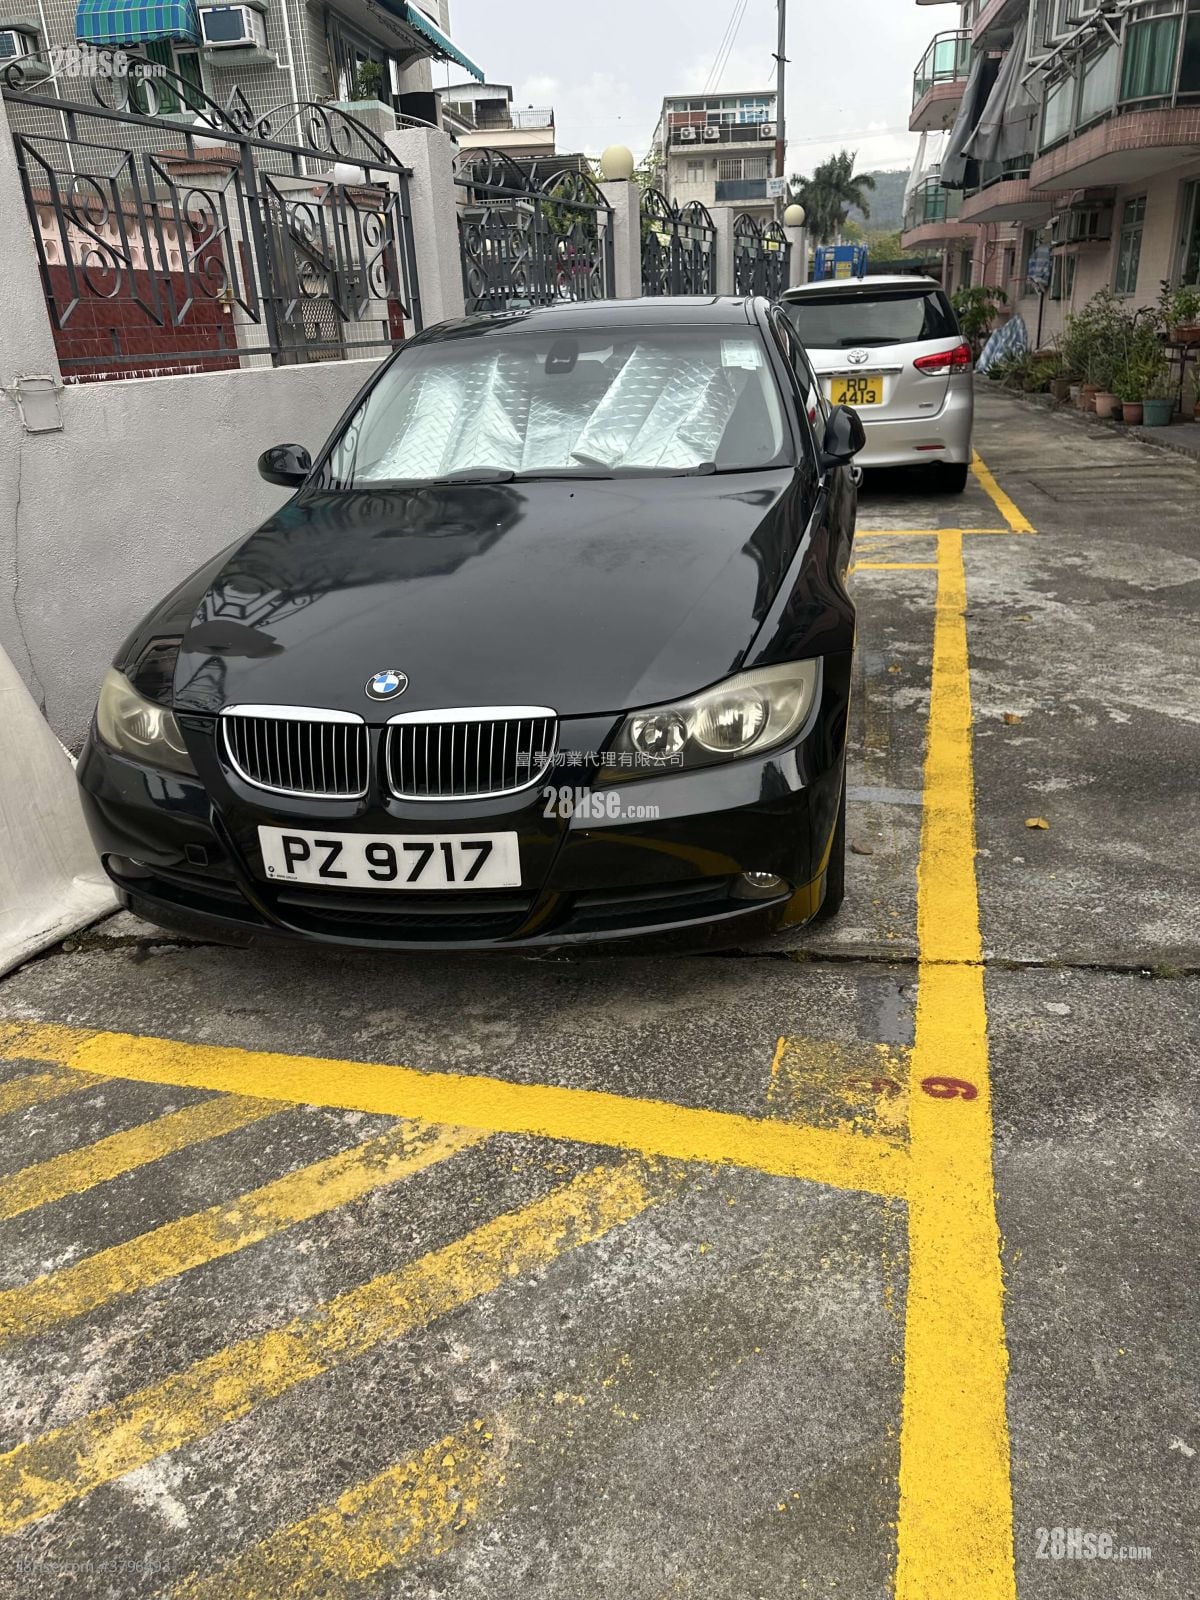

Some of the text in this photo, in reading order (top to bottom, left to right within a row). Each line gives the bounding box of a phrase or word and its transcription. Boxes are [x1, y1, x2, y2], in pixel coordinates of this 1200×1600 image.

[847, 378, 868, 391] RD
[838, 390, 876, 404] 4413
[281, 835, 493, 882] PZ 9717
